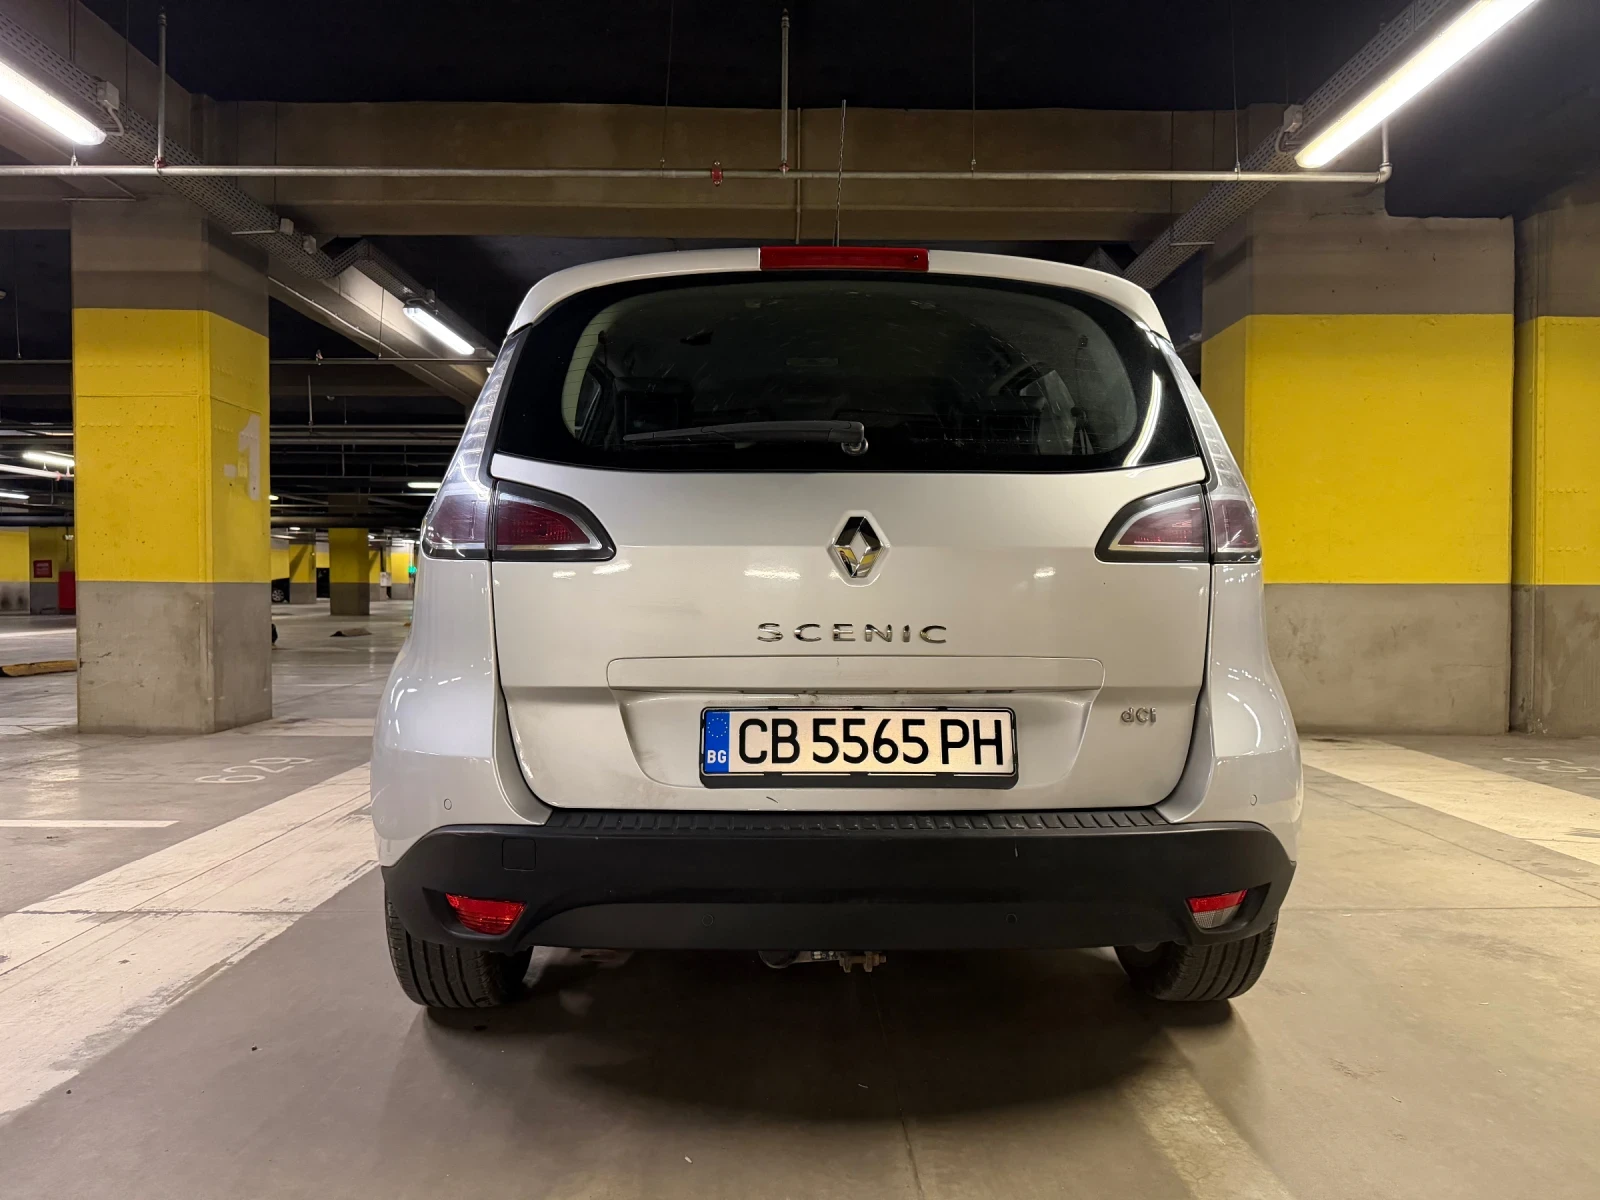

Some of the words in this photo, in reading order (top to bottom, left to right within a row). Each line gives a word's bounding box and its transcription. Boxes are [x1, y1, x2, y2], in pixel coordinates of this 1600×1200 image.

[757, 622, 947, 643] SCENIC
[812, 718, 929, 764] 5565
[706, 749, 727, 764] BG
